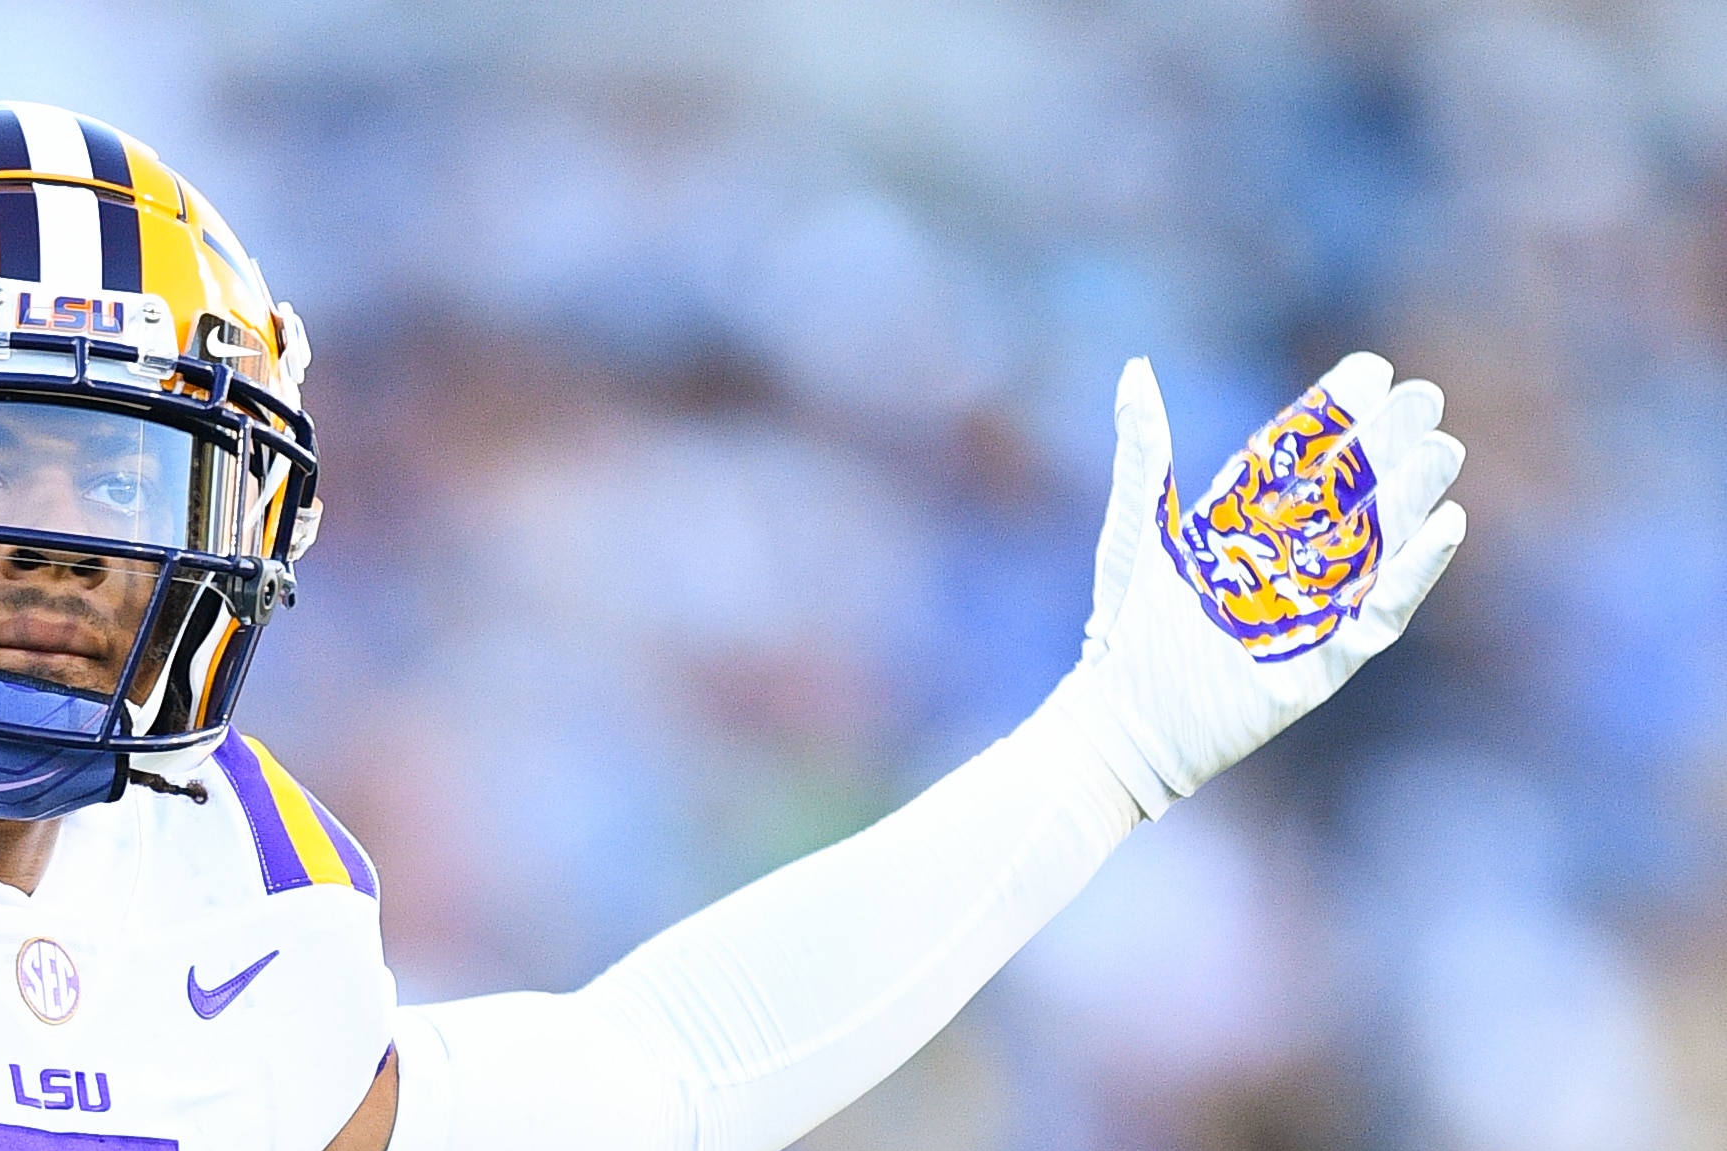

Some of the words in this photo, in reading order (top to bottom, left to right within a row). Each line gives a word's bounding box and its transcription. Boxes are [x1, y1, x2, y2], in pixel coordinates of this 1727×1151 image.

[15, 292, 123, 336] LSU
[19, 940, 79, 1019] SEC
[9, 1063, 111, 1112] LSU
